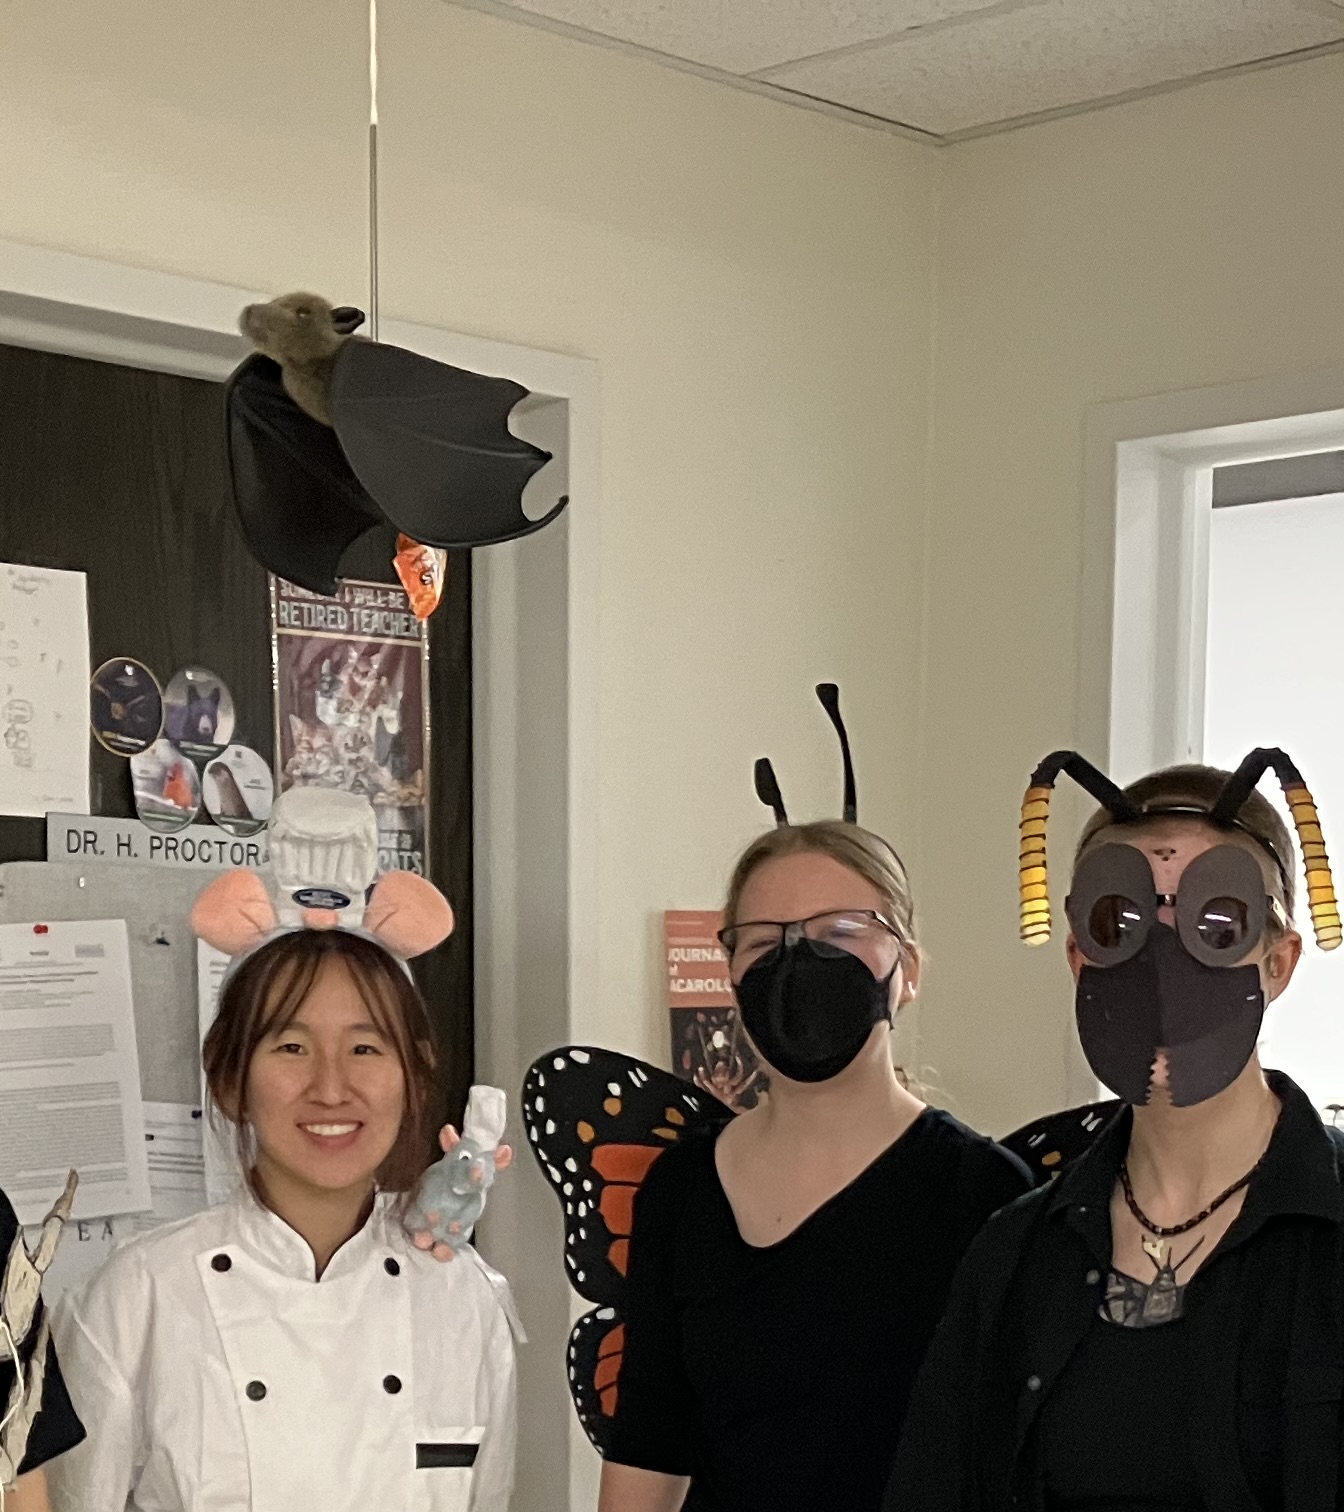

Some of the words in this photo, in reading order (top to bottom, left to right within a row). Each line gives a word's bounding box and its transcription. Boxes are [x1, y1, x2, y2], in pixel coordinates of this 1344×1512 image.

[278, 600, 348, 630] RETIRED
[349, 608, 420, 638] TEACHER
[66, 829, 105, 856] DR.
[116, 833, 138, 858] H.
[149, 835, 261, 866] PROCTOR
